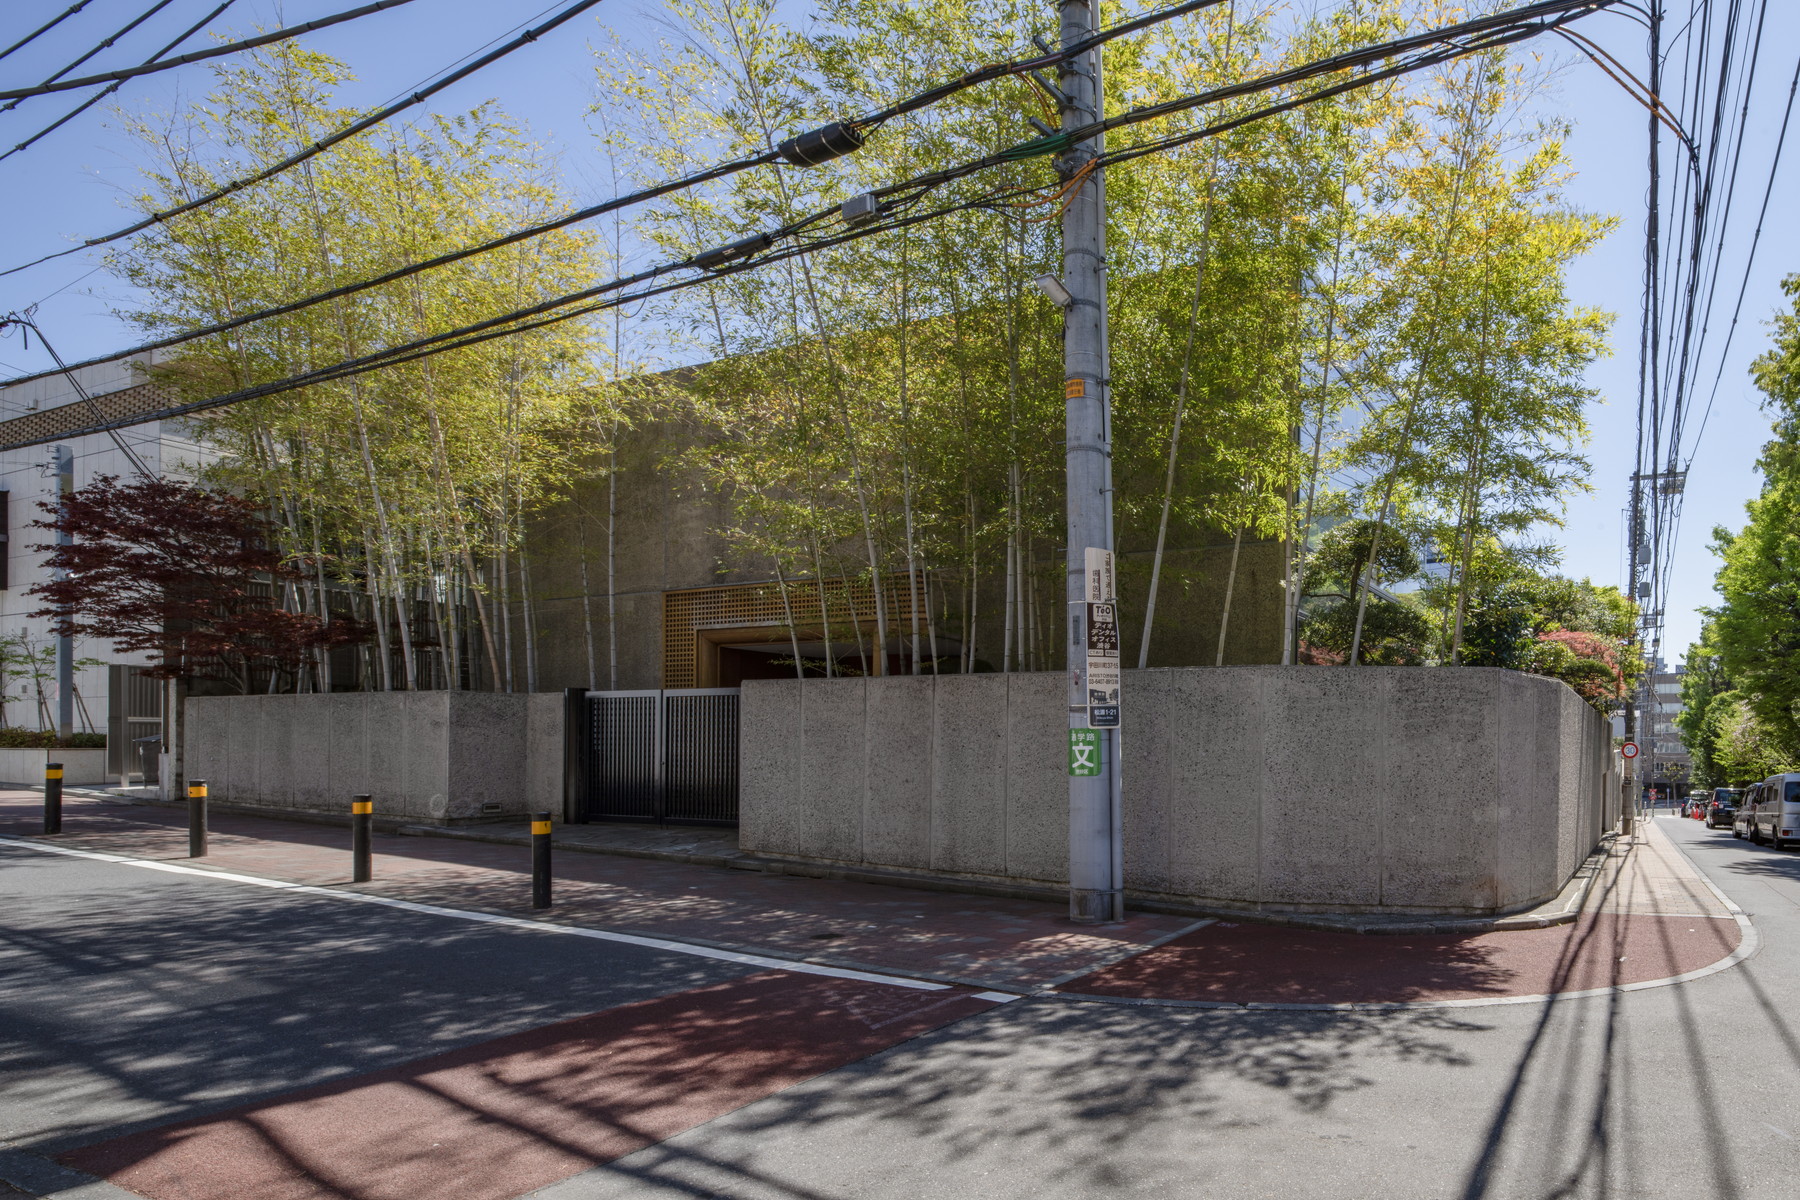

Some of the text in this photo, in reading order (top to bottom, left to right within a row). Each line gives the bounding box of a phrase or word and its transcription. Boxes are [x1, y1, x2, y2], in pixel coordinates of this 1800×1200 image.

[1093, 569, 1101, 601] 歯科医院
[1072, 733, 1094, 742] 通学路
[1072, 743, 1093, 768] 文
